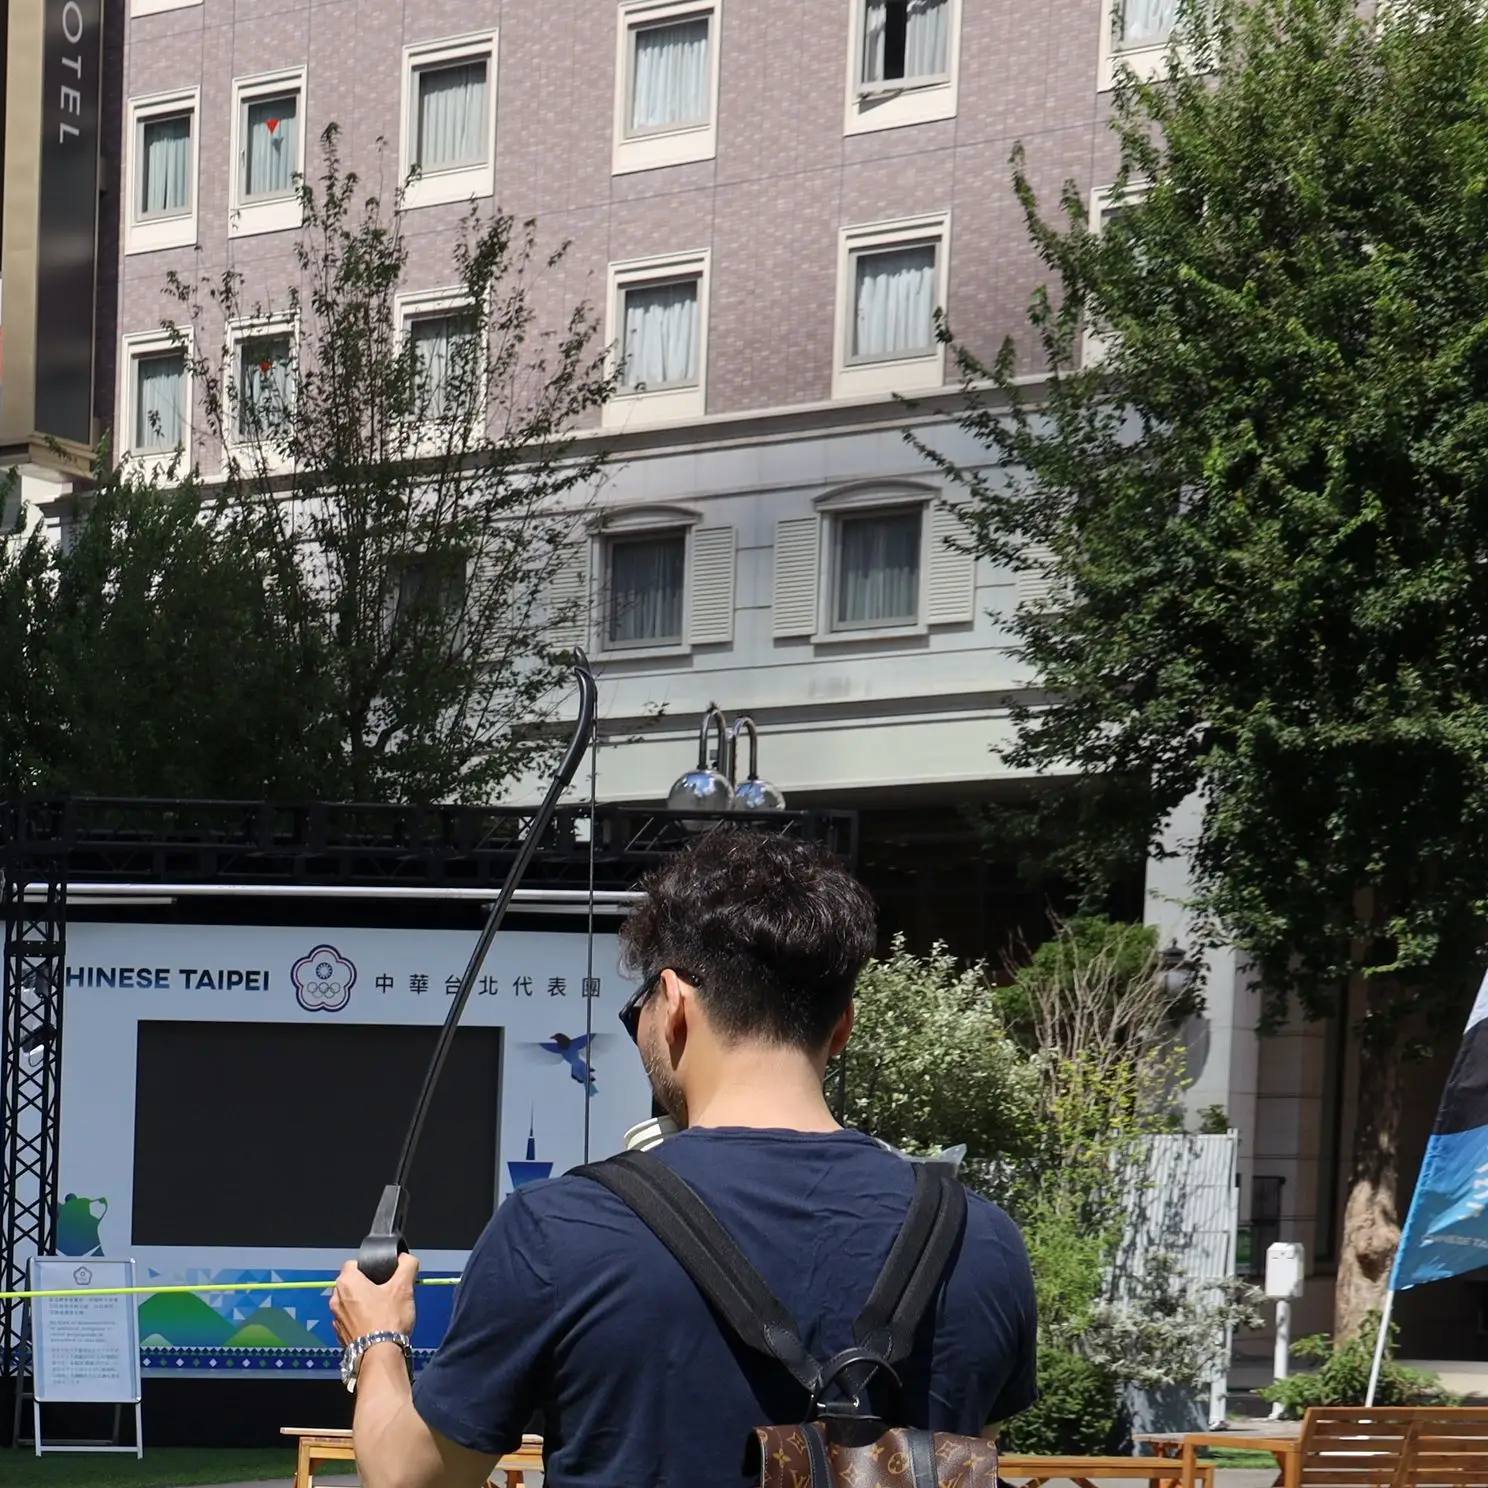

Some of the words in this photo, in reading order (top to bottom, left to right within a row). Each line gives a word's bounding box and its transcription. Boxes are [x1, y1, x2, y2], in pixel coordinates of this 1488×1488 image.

[65, 966, 171, 990] HINESE
[179, 969, 270, 991] TAIPEI
[374, 973, 602, 999] 中華台北代表團
